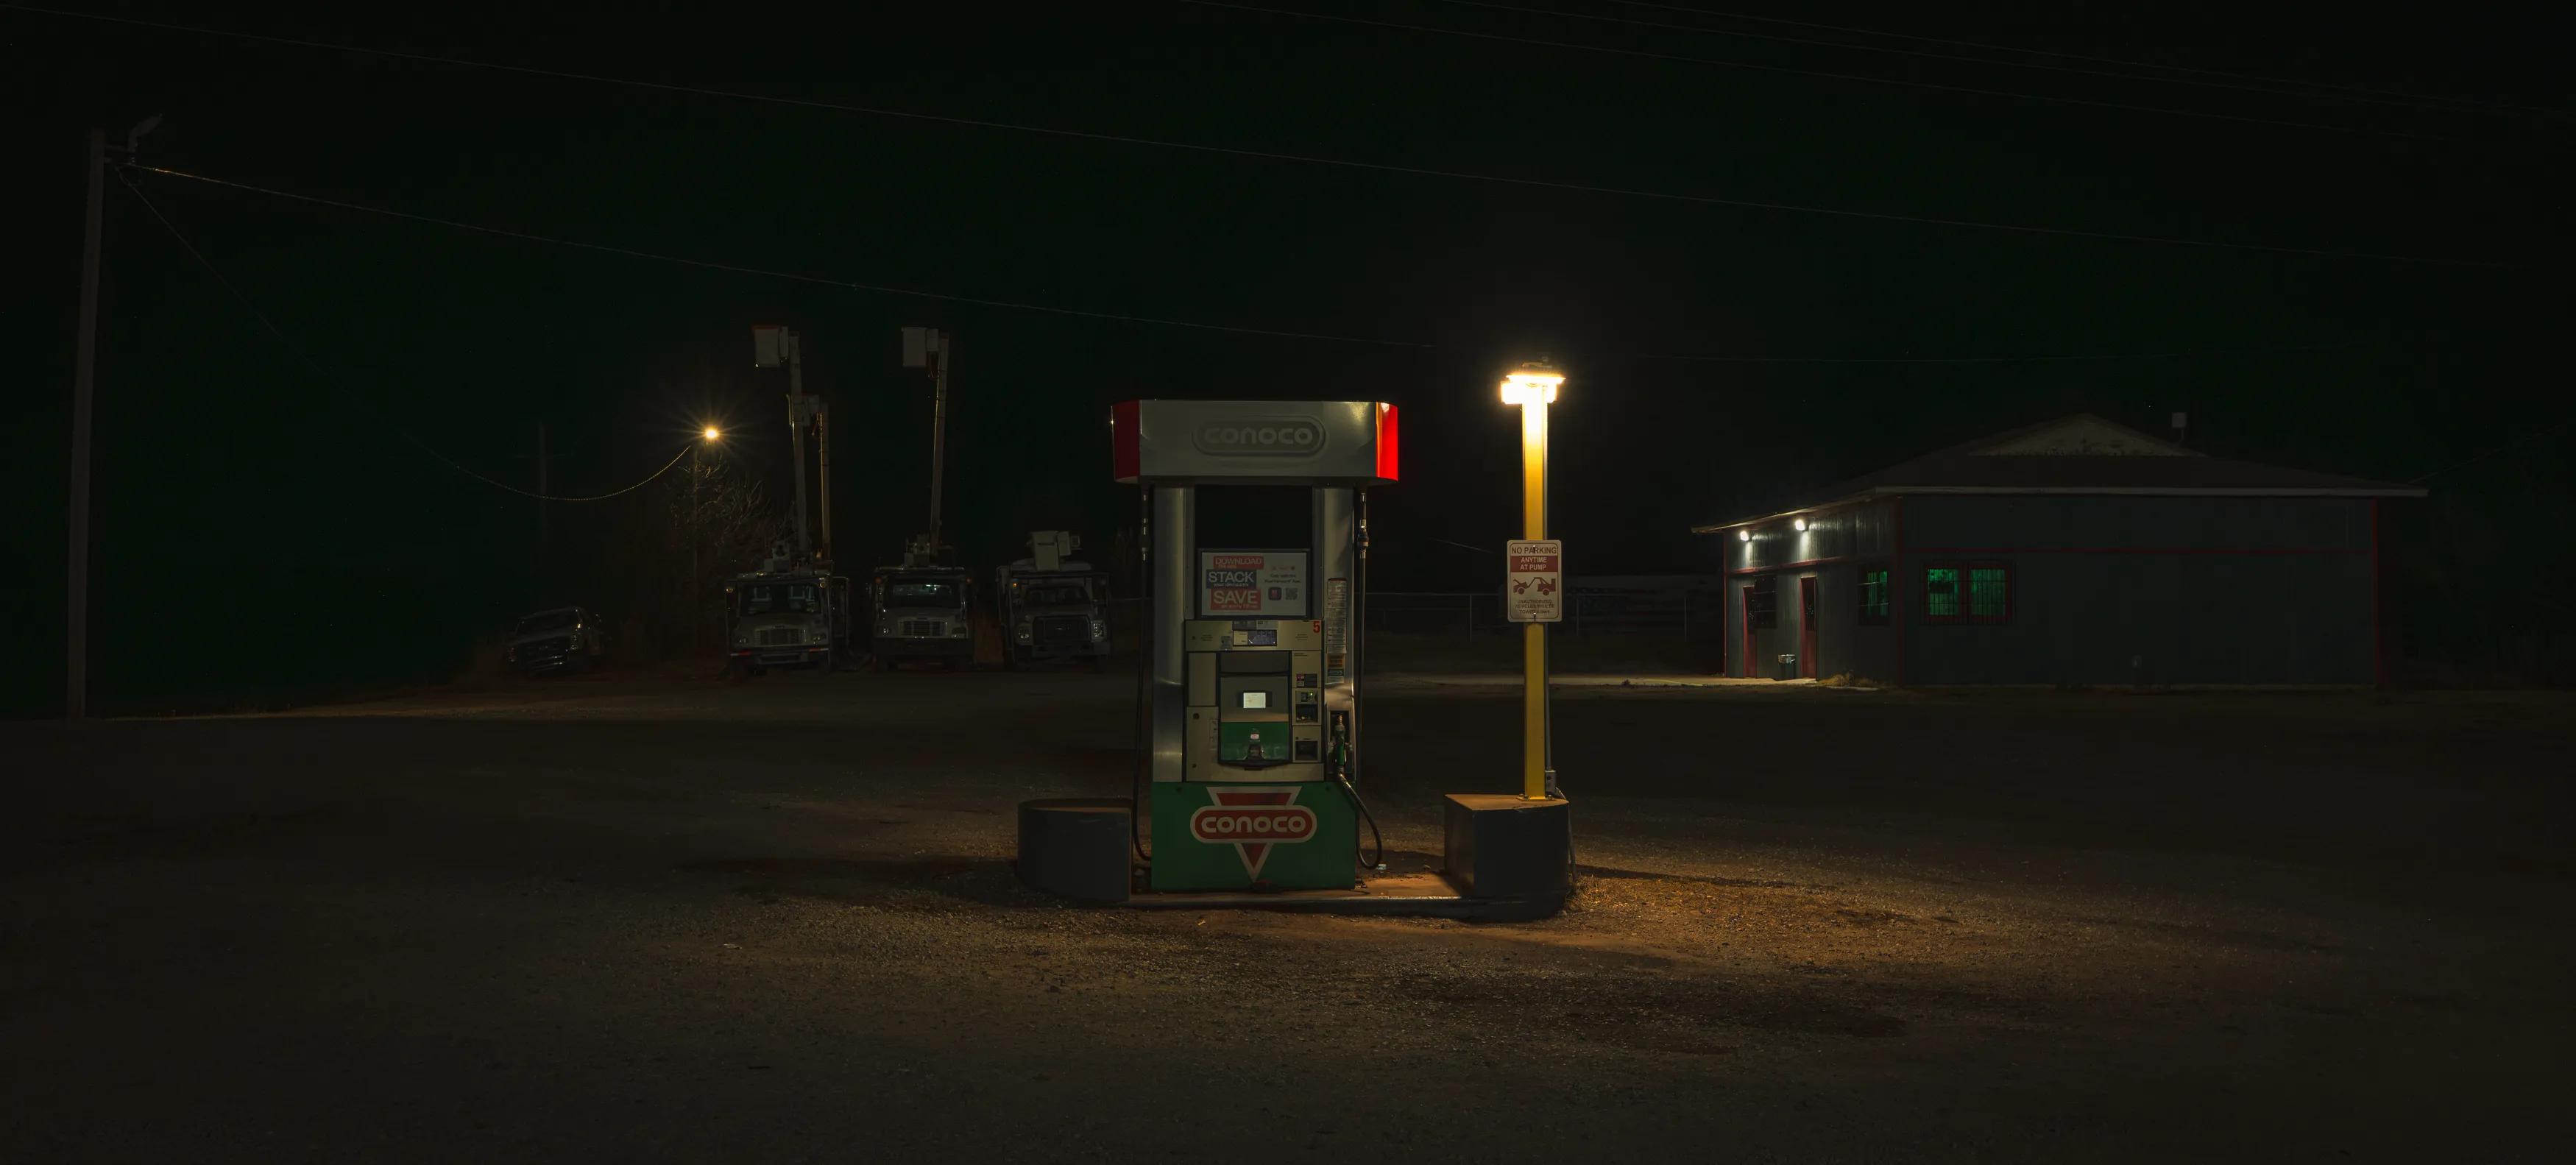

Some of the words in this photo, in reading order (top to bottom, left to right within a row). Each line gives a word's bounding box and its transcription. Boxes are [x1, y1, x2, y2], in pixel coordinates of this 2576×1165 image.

[1208, 571, 1254, 583] STACK
[1213, 590, 1258, 604] SAVE
[1313, 620, 1320, 633] 5
[1200, 815, 1306, 833] conoco
